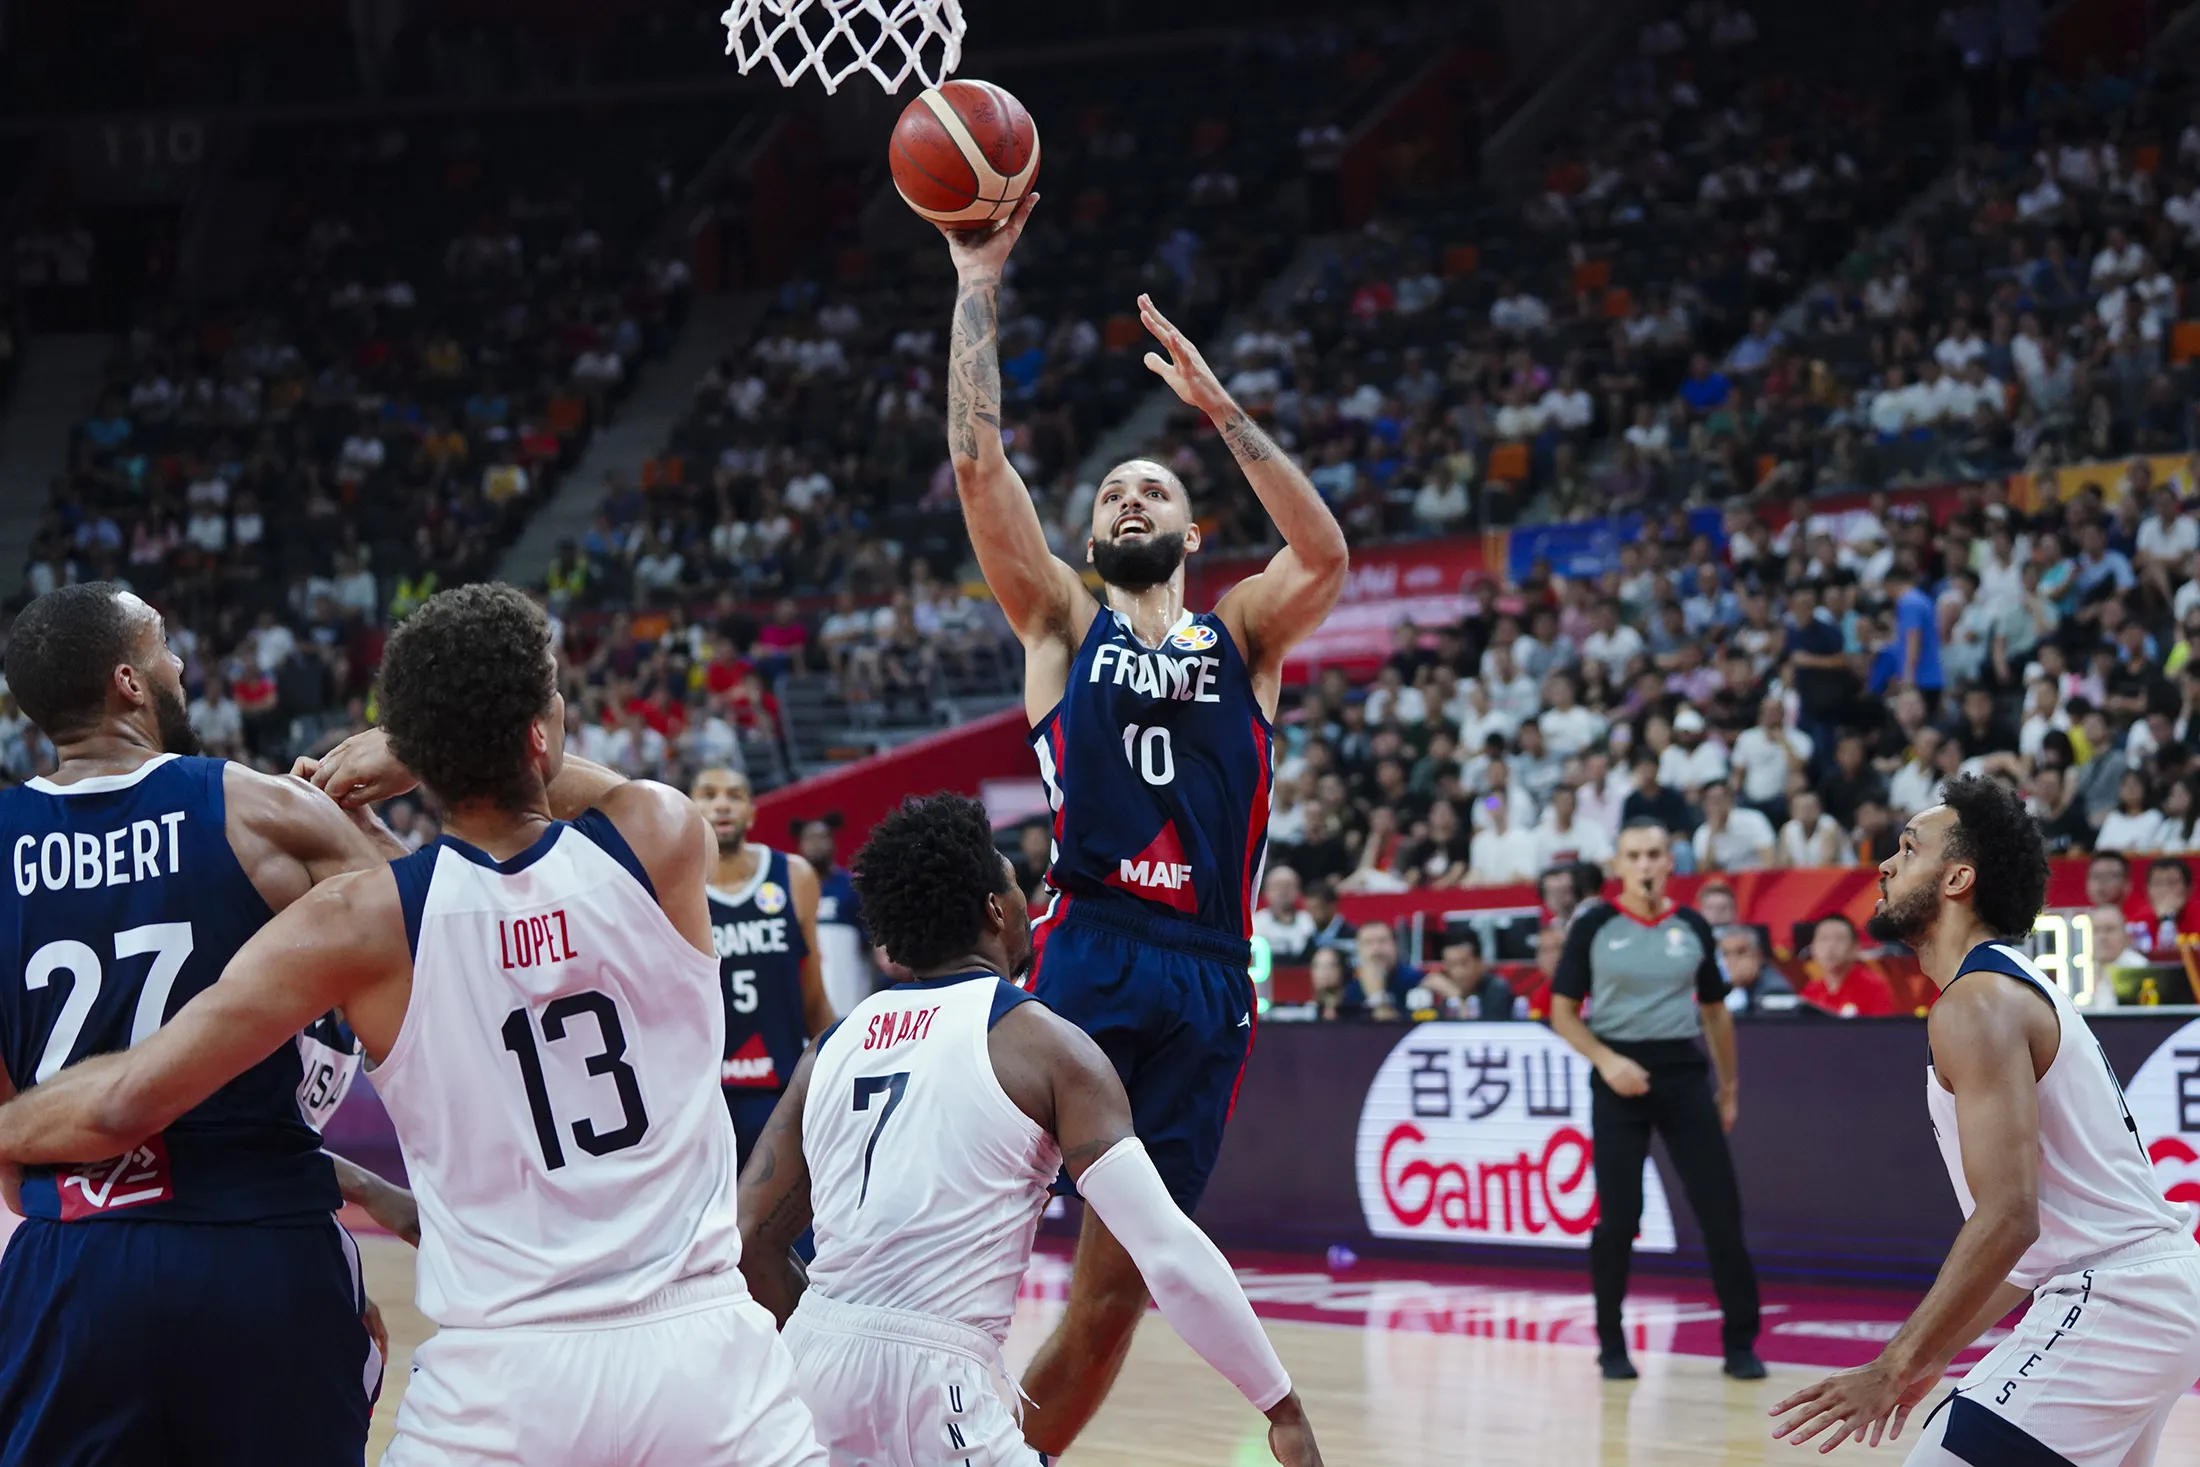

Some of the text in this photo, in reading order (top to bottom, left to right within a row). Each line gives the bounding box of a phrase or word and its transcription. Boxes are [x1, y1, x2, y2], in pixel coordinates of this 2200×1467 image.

[1089, 644, 1220, 703] FRANCE
[1122, 723, 1175, 786] 10
[13, 811, 185, 896] GOBERT
[1119, 859, 1192, 890] MAIF
[499, 910, 578, 969] LOPEZ
[711, 917, 789, 957] RANCE
[24, 921, 194, 1085] 27
[731, 969, 758, 1013] 5
[863, 1006, 941, 1050] SMART
[302, 1059, 348, 1112] USA
[501, 990, 649, 1171] 13
[1408, 1046, 1573, 1119] 百岁山
[852, 1071, 911, 1211] 7
[1381, 1122, 1640, 1239] Gante
